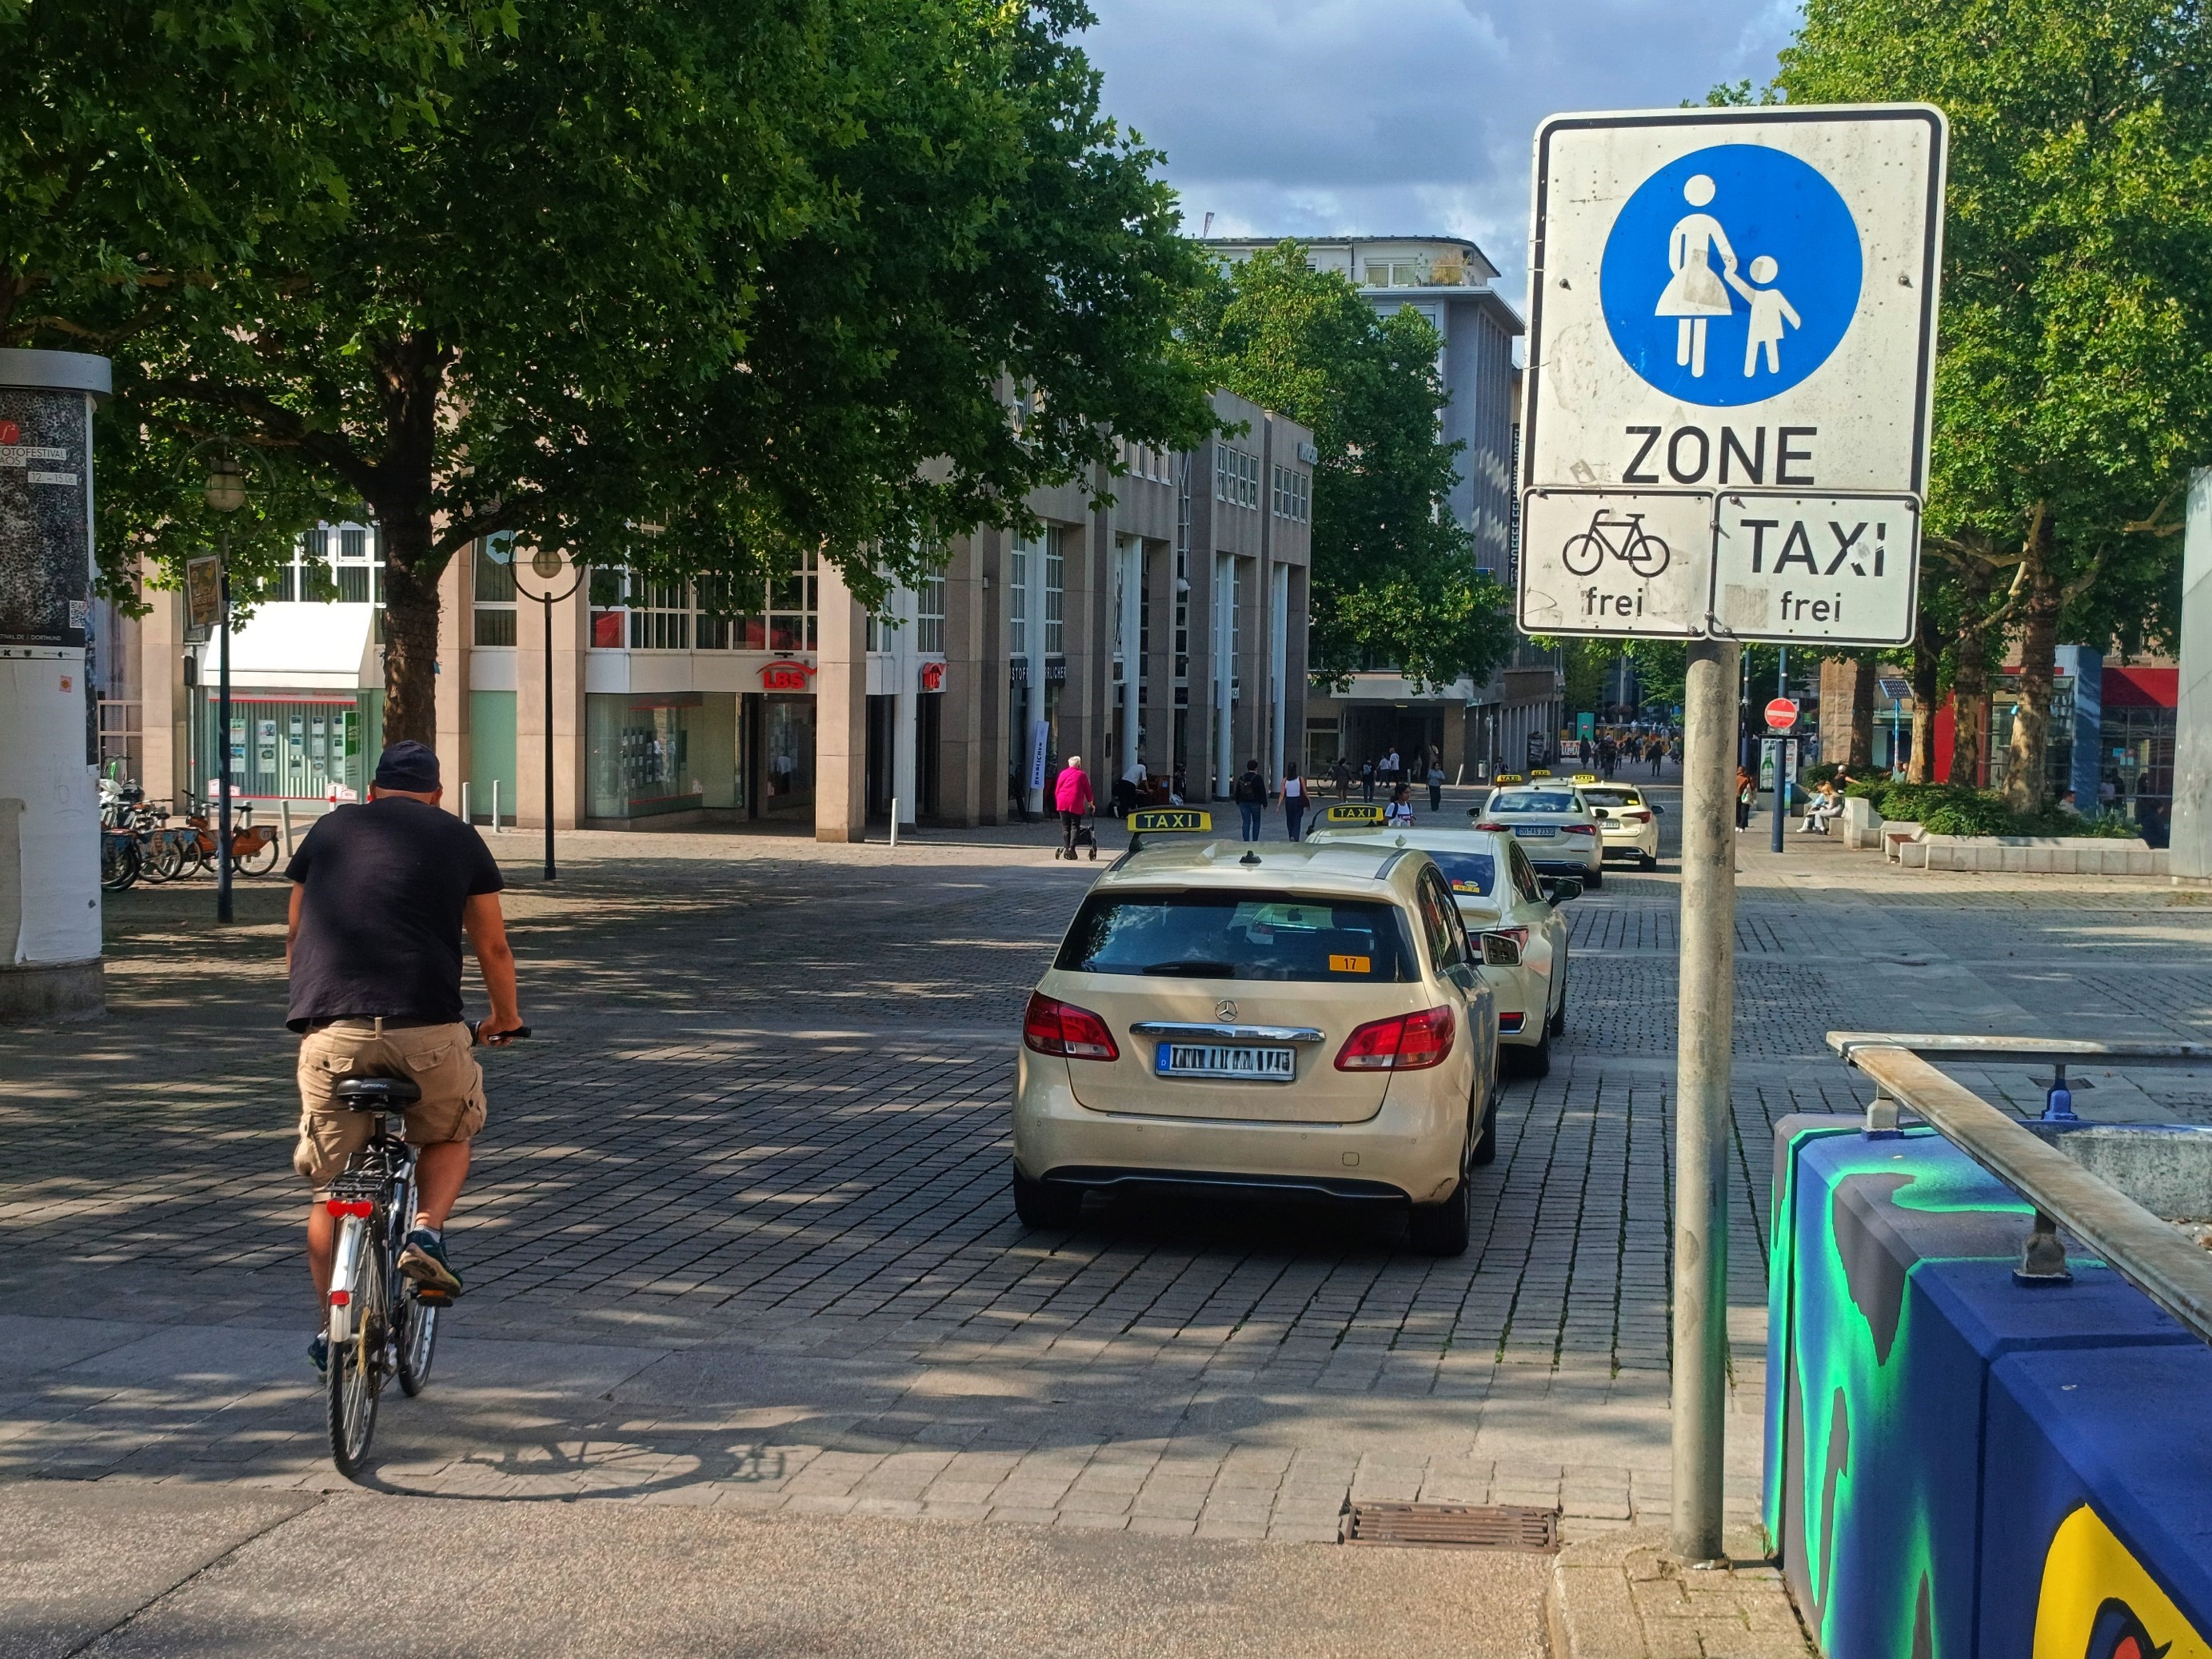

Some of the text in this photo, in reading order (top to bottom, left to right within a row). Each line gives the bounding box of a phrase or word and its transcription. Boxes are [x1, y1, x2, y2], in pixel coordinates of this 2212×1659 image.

[0, 447, 65, 458] OTOFESTIVAL
[1623, 426, 1818, 485] ZONE
[1740, 519, 1887, 578] TAXI
[1585, 586, 1643, 618] frei
[1780, 590, 1842, 623] frei
[764, 671, 805, 690] LBS
[1144, 814, 1193, 828] TAXI
[1338, 808, 1372, 818] TAXI
[1344, 957, 1357, 970] 17
